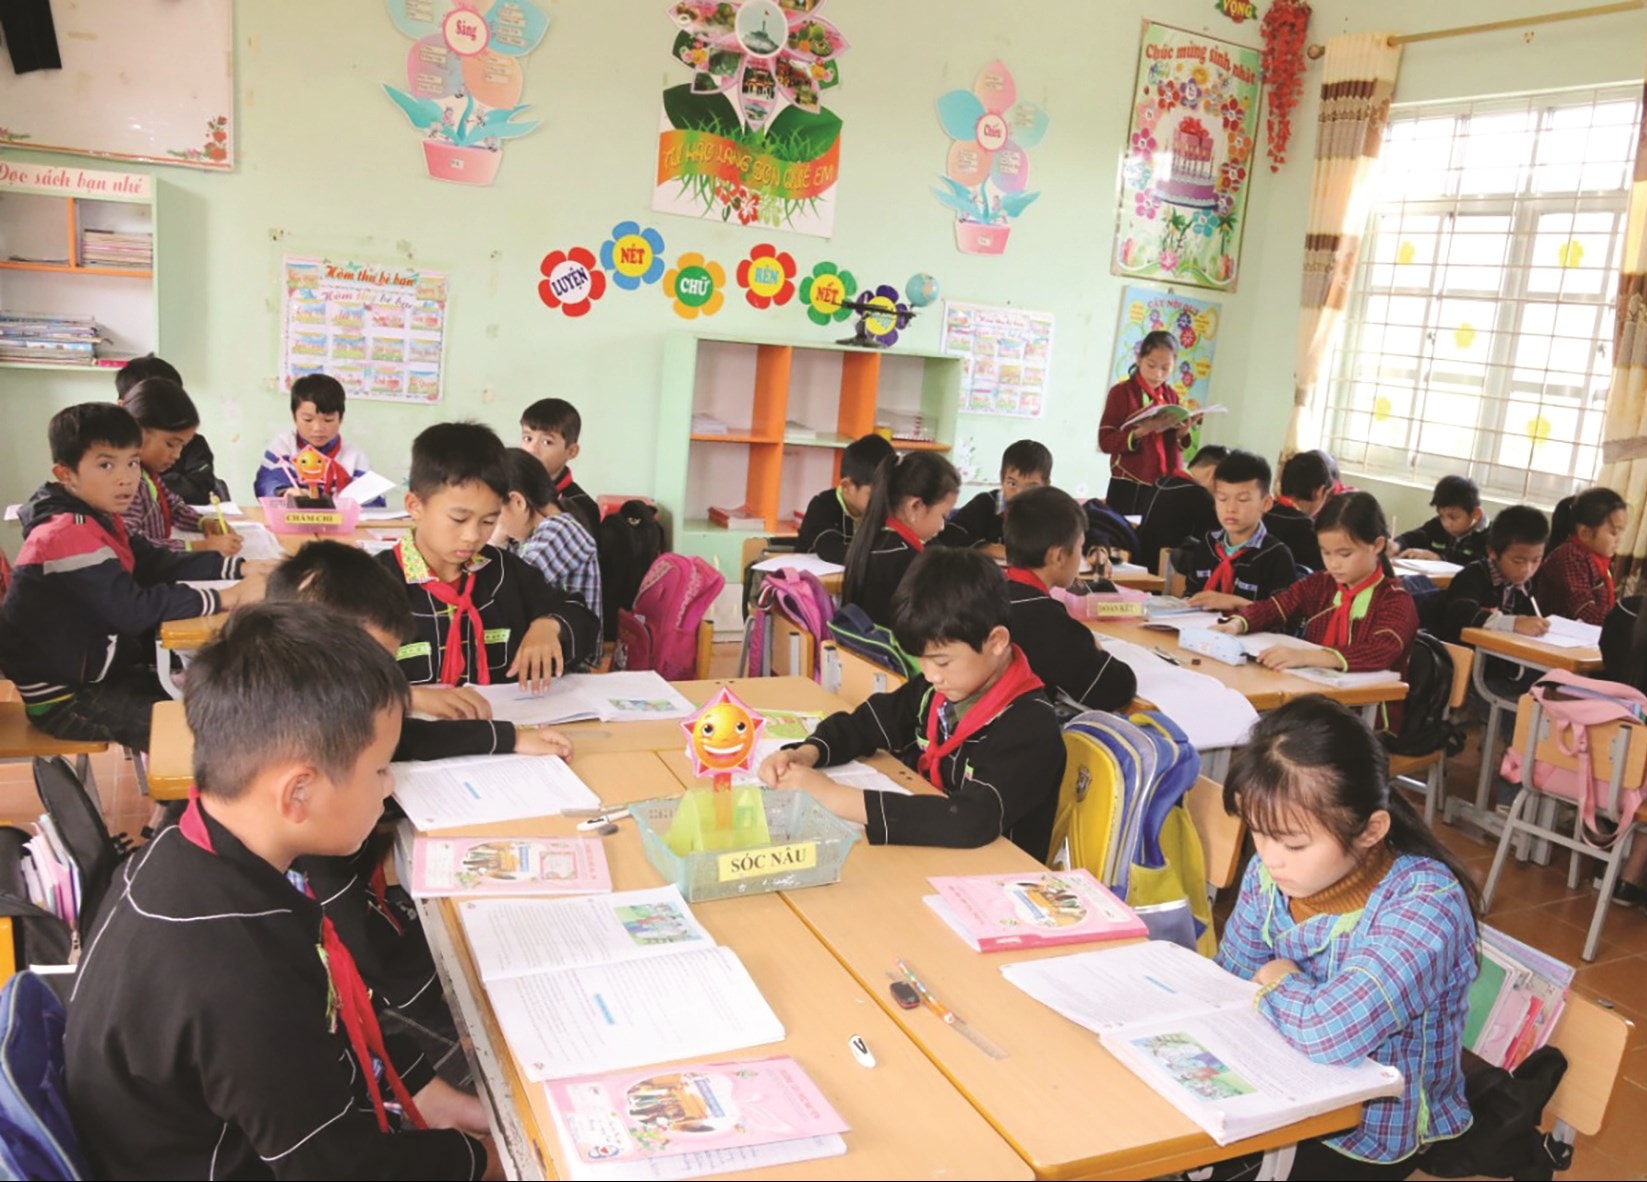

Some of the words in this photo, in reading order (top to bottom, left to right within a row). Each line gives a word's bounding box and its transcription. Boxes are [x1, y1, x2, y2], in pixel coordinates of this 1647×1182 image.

[34, 169, 70, 188] sách
[551, 266, 588, 296] LUYỆN
[680, 275, 710, 296] CHỮ
[731, 853, 766, 873] SÓC
[771, 846, 806, 867] NÂU
